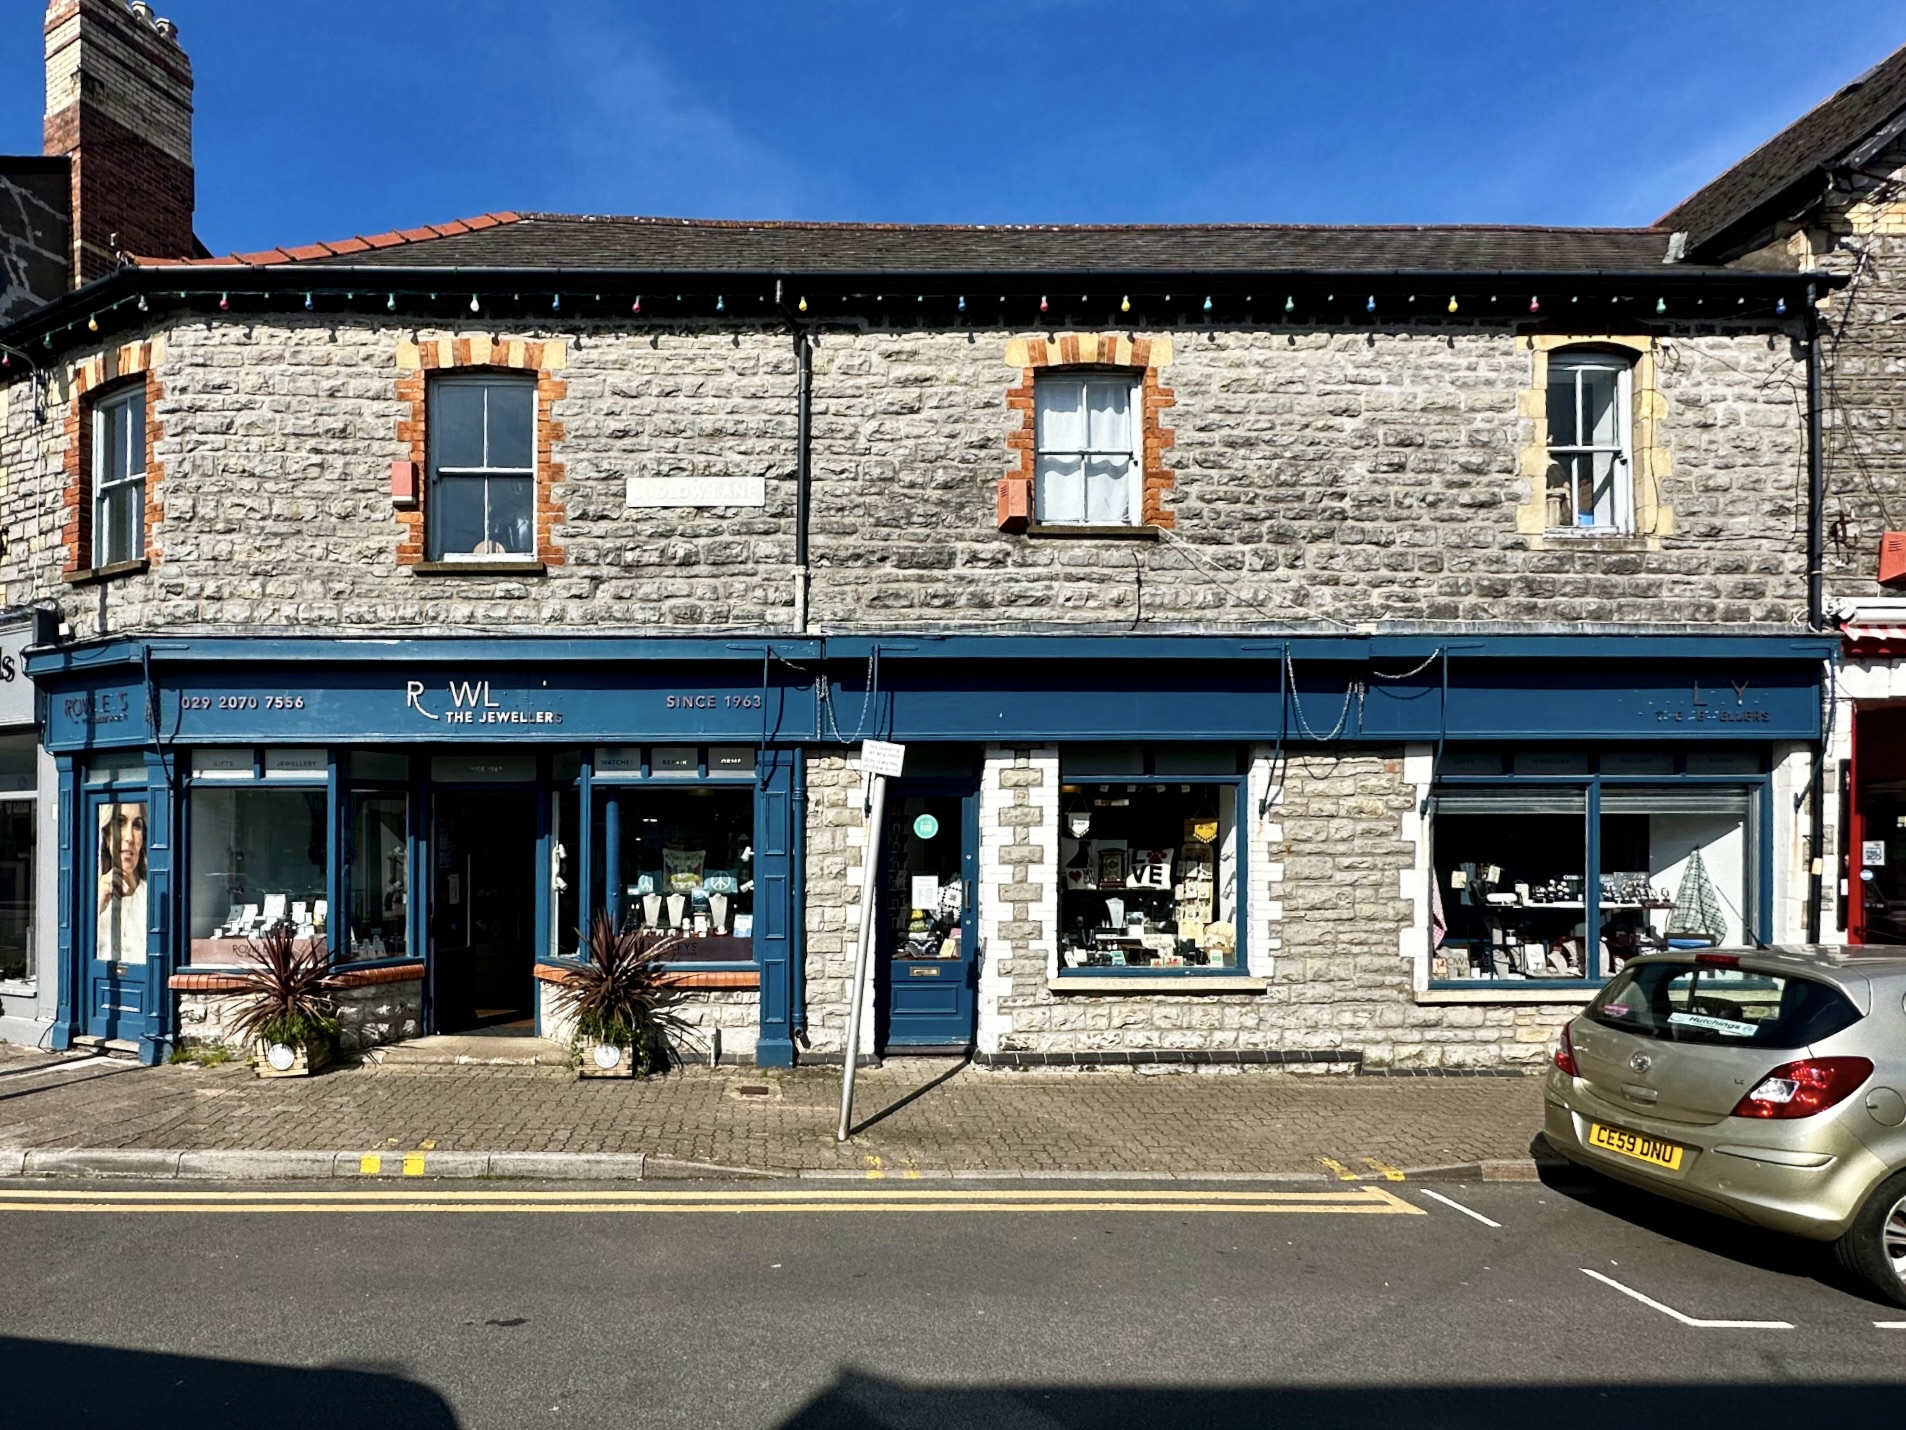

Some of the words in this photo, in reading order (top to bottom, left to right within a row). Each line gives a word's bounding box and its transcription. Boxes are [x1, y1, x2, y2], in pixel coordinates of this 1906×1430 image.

[712, 484, 758, 499] LANE
[181, 696, 210, 709] 029
[219, 696, 257, 709] 2070
[265, 696, 304, 709] 7556
[666, 695, 717, 708] SINCE
[724, 695, 762, 708] 1963
[446, 711, 473, 723] THE
[479, 711, 563, 723] JEWELLERS
[1688, 1016, 1741, 1031] Hutchings
[1597, 1126, 1637, 1152] CE59
[1640, 1138, 1674, 1163] DNU
